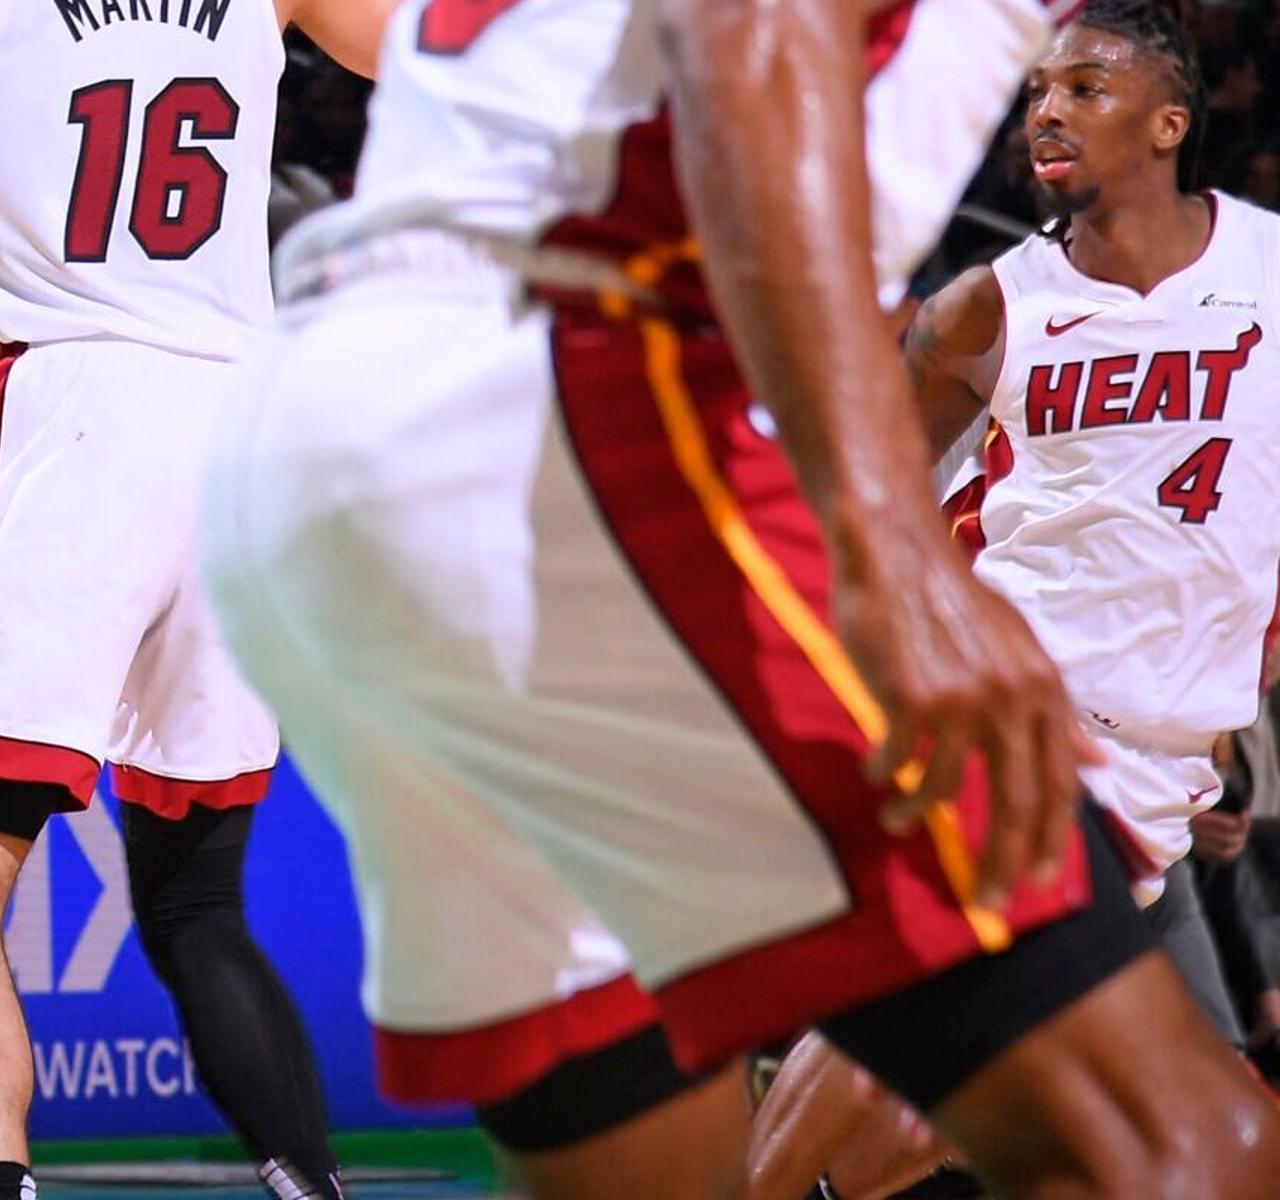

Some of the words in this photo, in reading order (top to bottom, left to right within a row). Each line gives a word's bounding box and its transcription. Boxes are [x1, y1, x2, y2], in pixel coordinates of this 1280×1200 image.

[63, 76, 240, 263] 16
[1024, 320, 1263, 438] HEAT
[1156, 437, 1234, 525] 4
